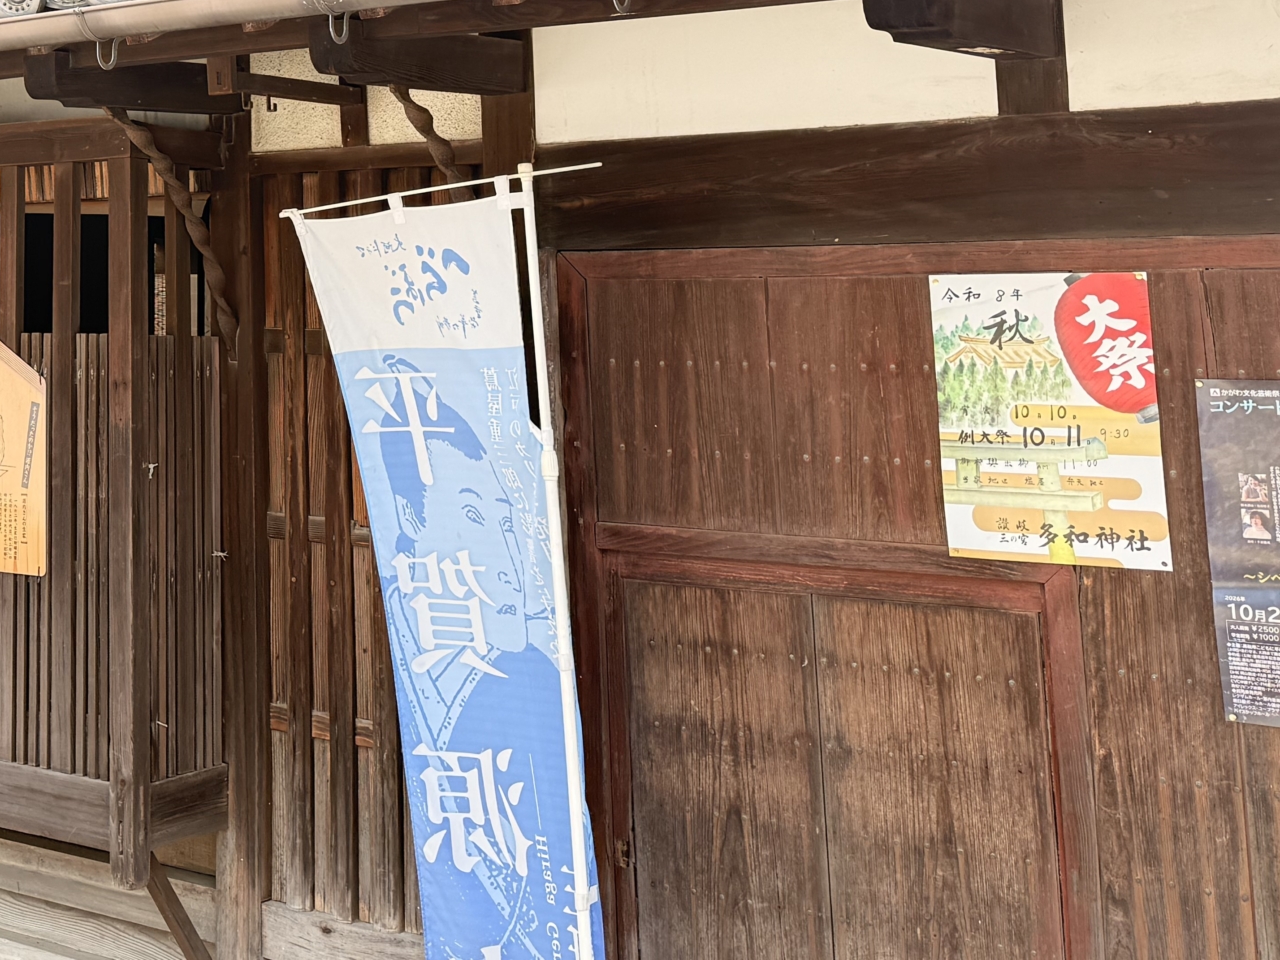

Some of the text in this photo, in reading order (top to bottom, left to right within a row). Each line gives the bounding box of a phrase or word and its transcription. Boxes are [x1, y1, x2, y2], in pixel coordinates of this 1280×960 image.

[941, 286, 1023, 302] 令和 8年
[983, 309, 1034, 350] 秋
[1075, 294, 1155, 392] 大祭
[958, 429, 1012, 446] 例大祭
[1100, 428, 1130, 443] 9:30
[1038, 523, 1152, 553] 多和神社
